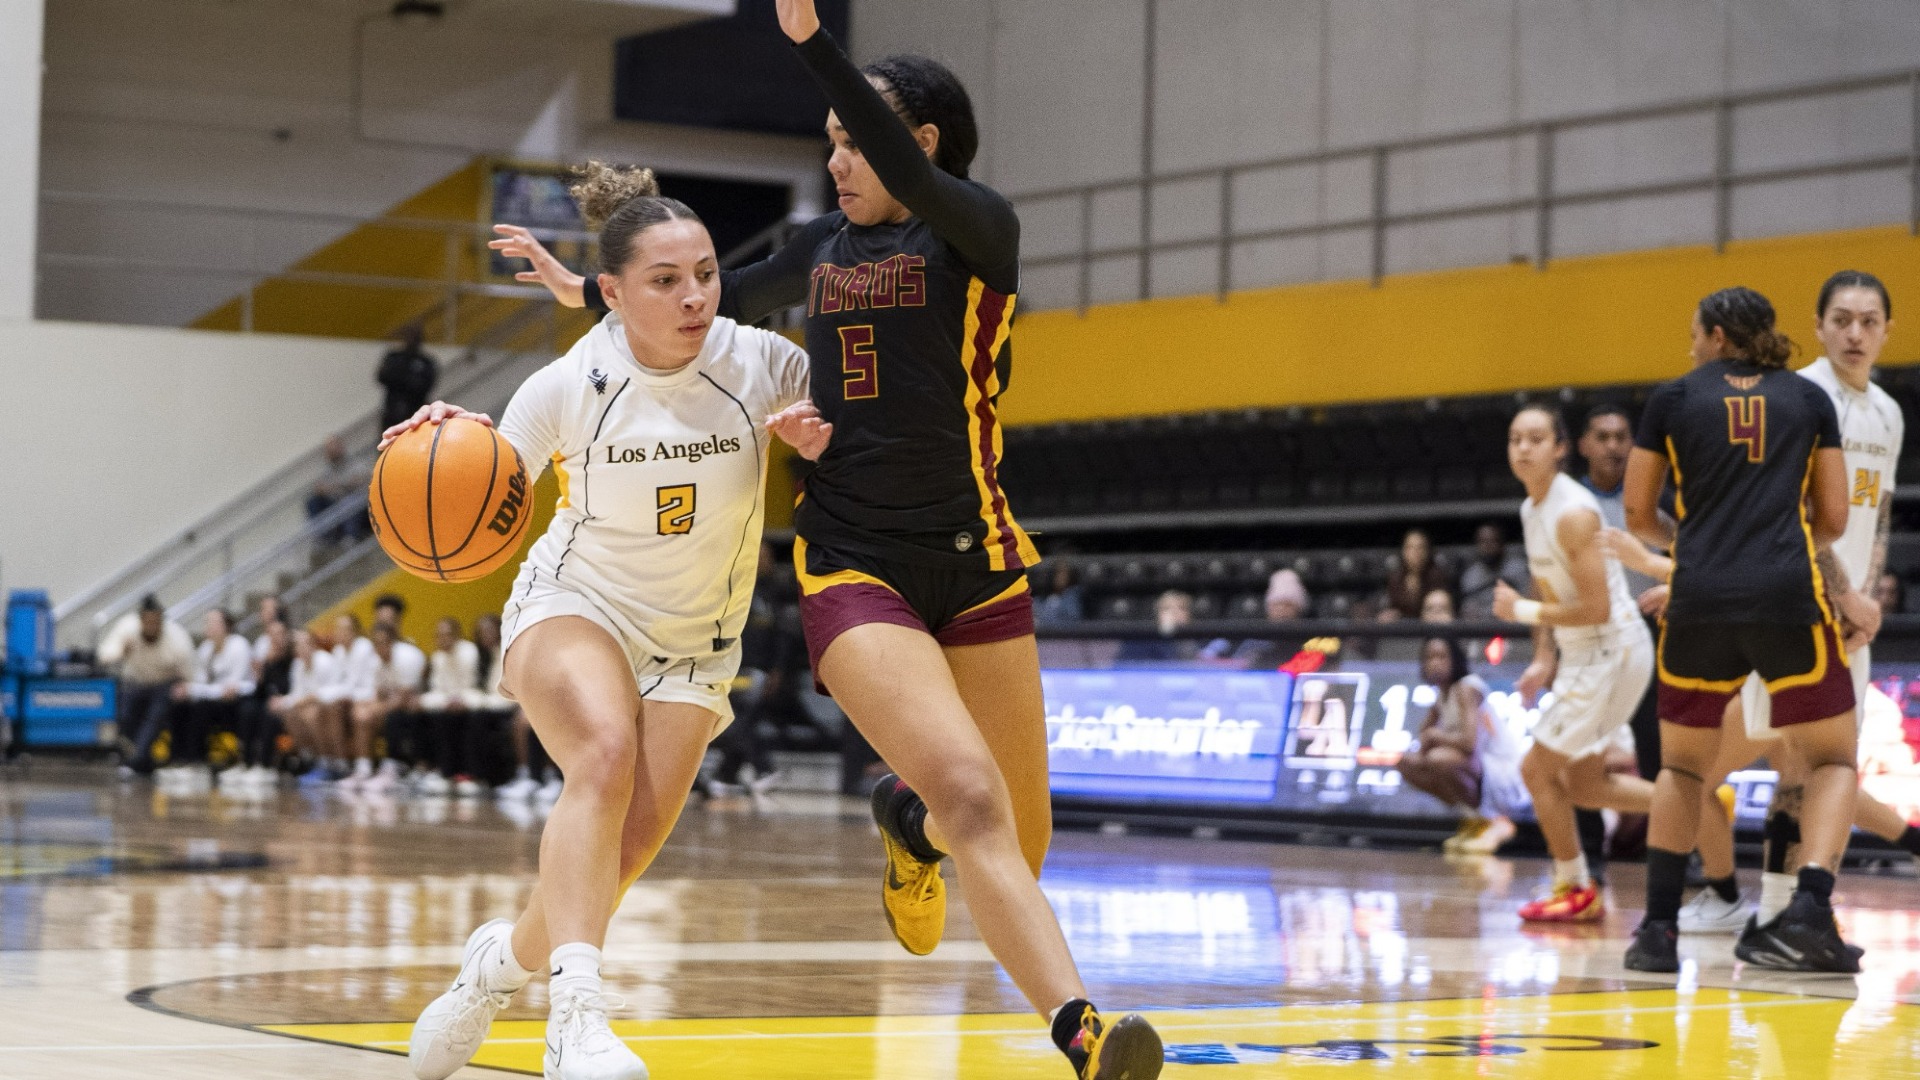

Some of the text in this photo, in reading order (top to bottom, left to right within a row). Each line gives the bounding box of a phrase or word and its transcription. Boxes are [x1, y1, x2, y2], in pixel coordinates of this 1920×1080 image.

[808, 254, 926, 317] TOROS
[837, 325, 878, 400] 5
[606, 434, 741, 464] Los Angeles
[1723, 395, 1766, 463] 4
[656, 483, 697, 536] 2
[1850, 468, 1881, 507] 24
